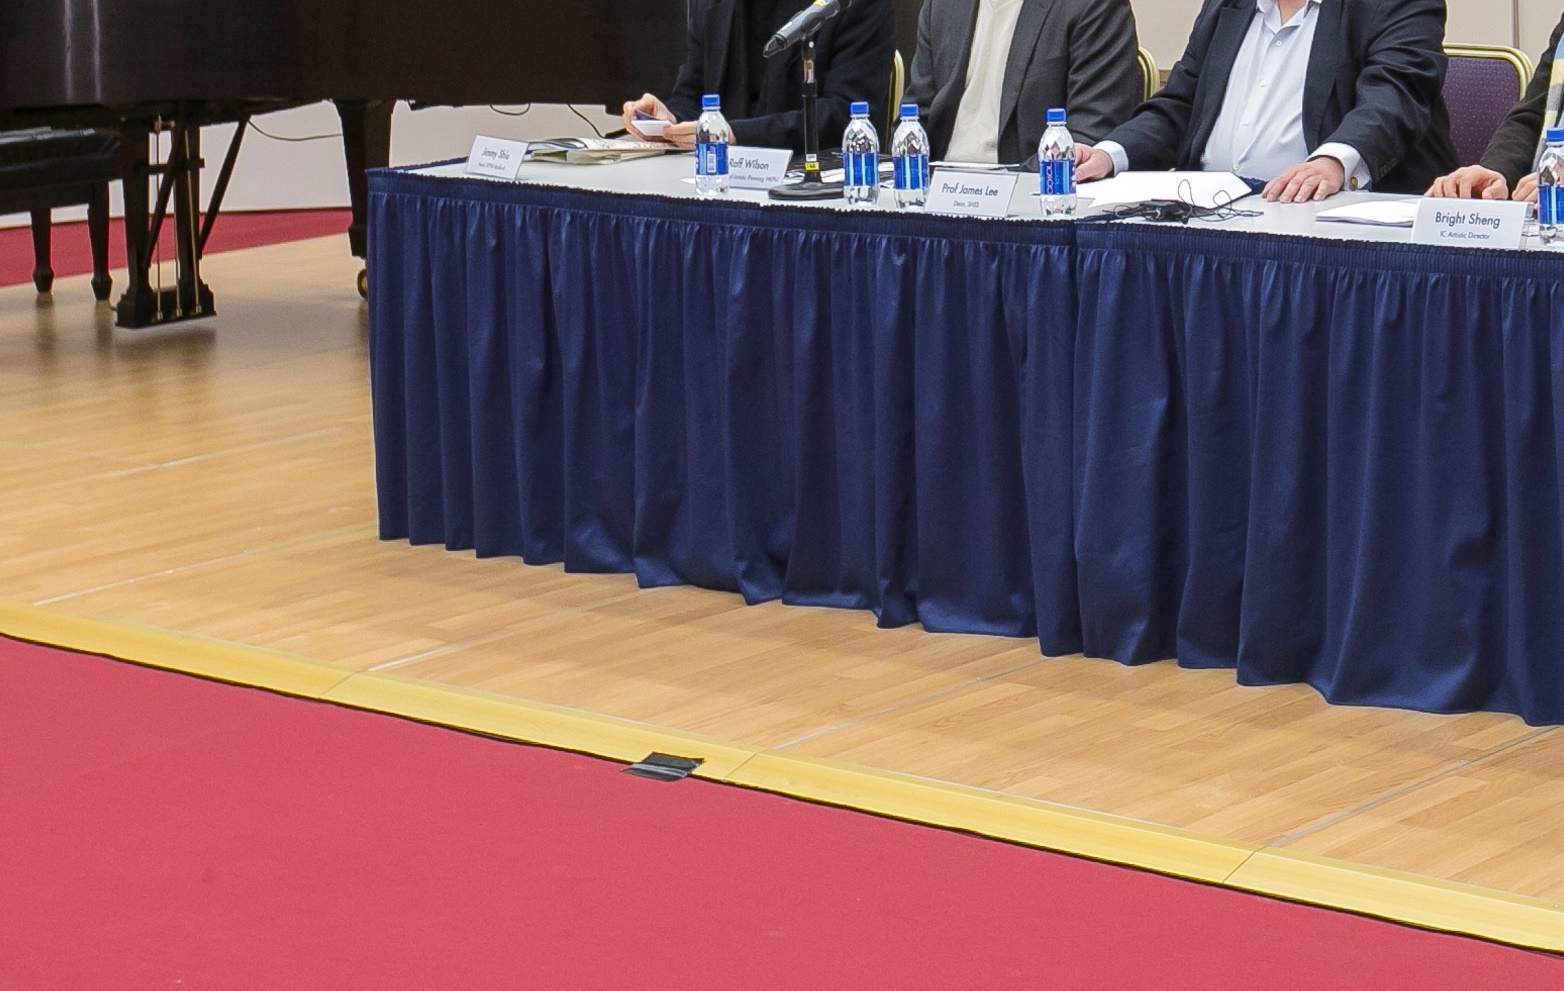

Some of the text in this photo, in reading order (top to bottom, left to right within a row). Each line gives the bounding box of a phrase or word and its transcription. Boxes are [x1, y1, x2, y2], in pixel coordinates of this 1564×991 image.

[729, 157, 769, 170] Raff Wilson
[942, 182, 998, 196] Prof James Lee
[1435, 211, 1500, 229] Bright Sheng
[1447, 231, 1467, 239] Artistic
[1468, 231, 1490, 240] Director
